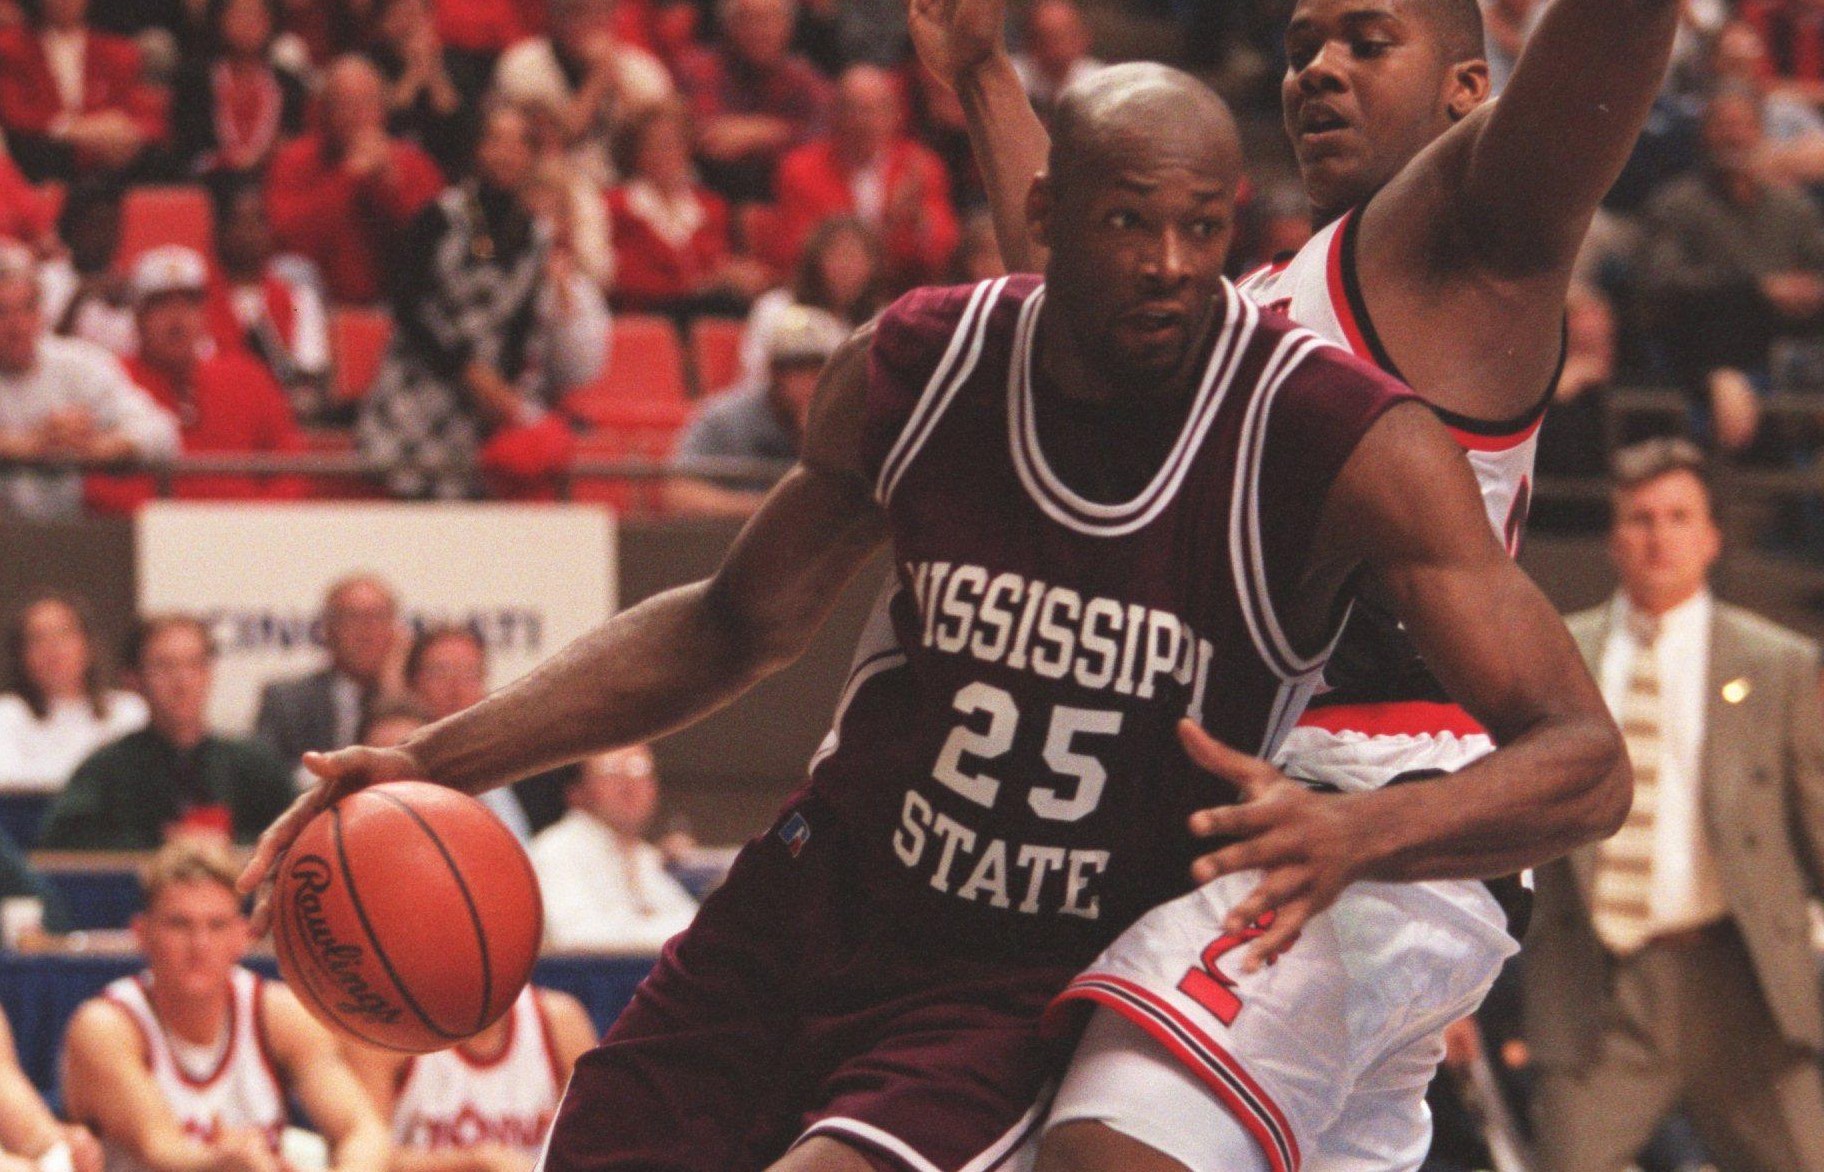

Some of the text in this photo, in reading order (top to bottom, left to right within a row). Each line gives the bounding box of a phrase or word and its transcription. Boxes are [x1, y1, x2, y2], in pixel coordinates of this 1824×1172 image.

[931, 681, 1124, 821] 25
[892, 788, 1110, 920] STATE
[290, 854, 402, 1024] Rawlings
